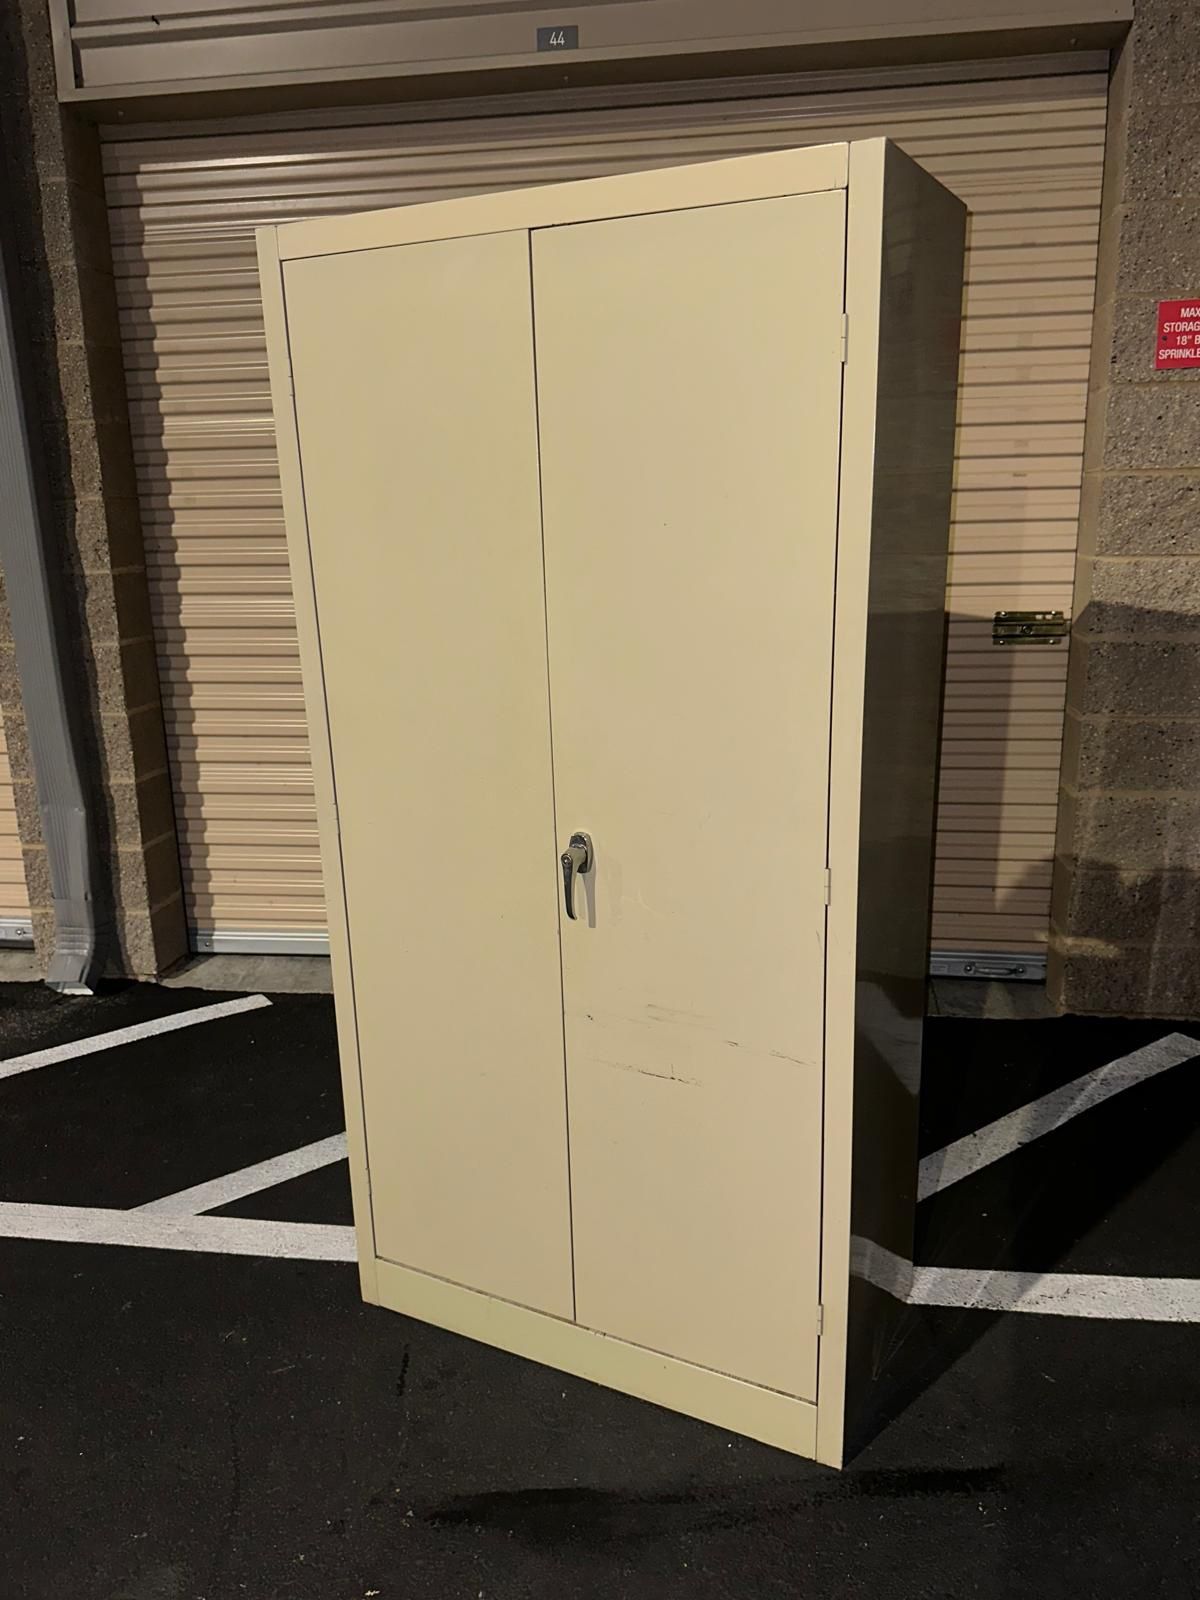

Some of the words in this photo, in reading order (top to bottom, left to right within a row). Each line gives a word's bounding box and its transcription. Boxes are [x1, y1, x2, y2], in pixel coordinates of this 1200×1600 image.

[550, 31, 565, 46] 44
[1180, 307, 1200, 318] MAX
[1176, 335, 1192, 345] 18"
